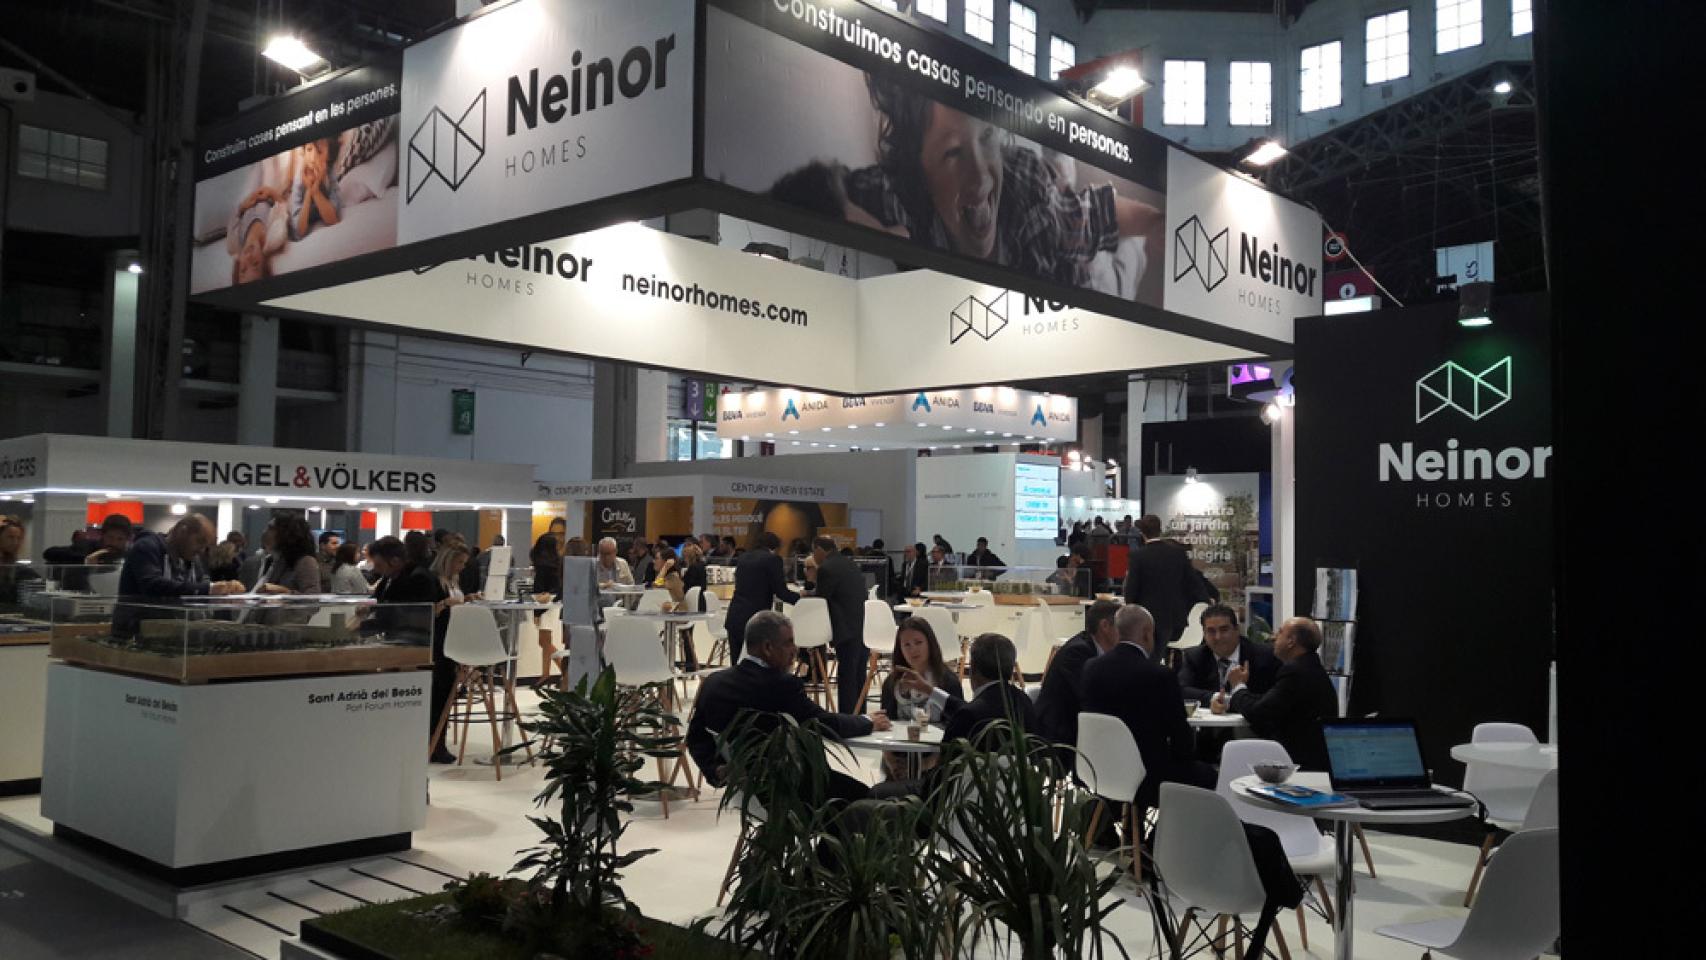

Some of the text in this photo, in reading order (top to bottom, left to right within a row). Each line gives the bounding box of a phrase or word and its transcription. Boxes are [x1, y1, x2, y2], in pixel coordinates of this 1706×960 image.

[506, 32, 676, 136] Neinor
[275, 110, 313, 141] pensant
[315, 108, 328, 124] en
[331, 102, 345, 118] les
[347, 84, 398, 116] persones.
[906, 48, 961, 88] casas
[964, 72, 1044, 125] pensando
[1047, 110, 1066, 136] en
[1069, 122, 1133, 163] personas.
[505, 135, 588, 178] HOMES
[470, 245, 593, 283] einor
[1240, 231, 1317, 297] Neinor
[466, 272, 535, 297] HOMES
[622, 272, 808, 327] neinorhomes.com
[1238, 288, 1282, 316] HOMES
[1023, 318, 1080, 335] HOMES
[691, 381, 698, 398] 3
[802, 400, 829, 411] ANIDA
[190, 460, 437, 493] ENGEL&VÖLKERS
[1379, 438, 1552, 482] Neinor
[731, 482, 769, 494] CENTURY
[780, 486, 797, 495] NEW
[1416, 492, 1512, 508] HOMES
[308, 693, 334, 704] Sant
[371, 689, 388, 700] del
